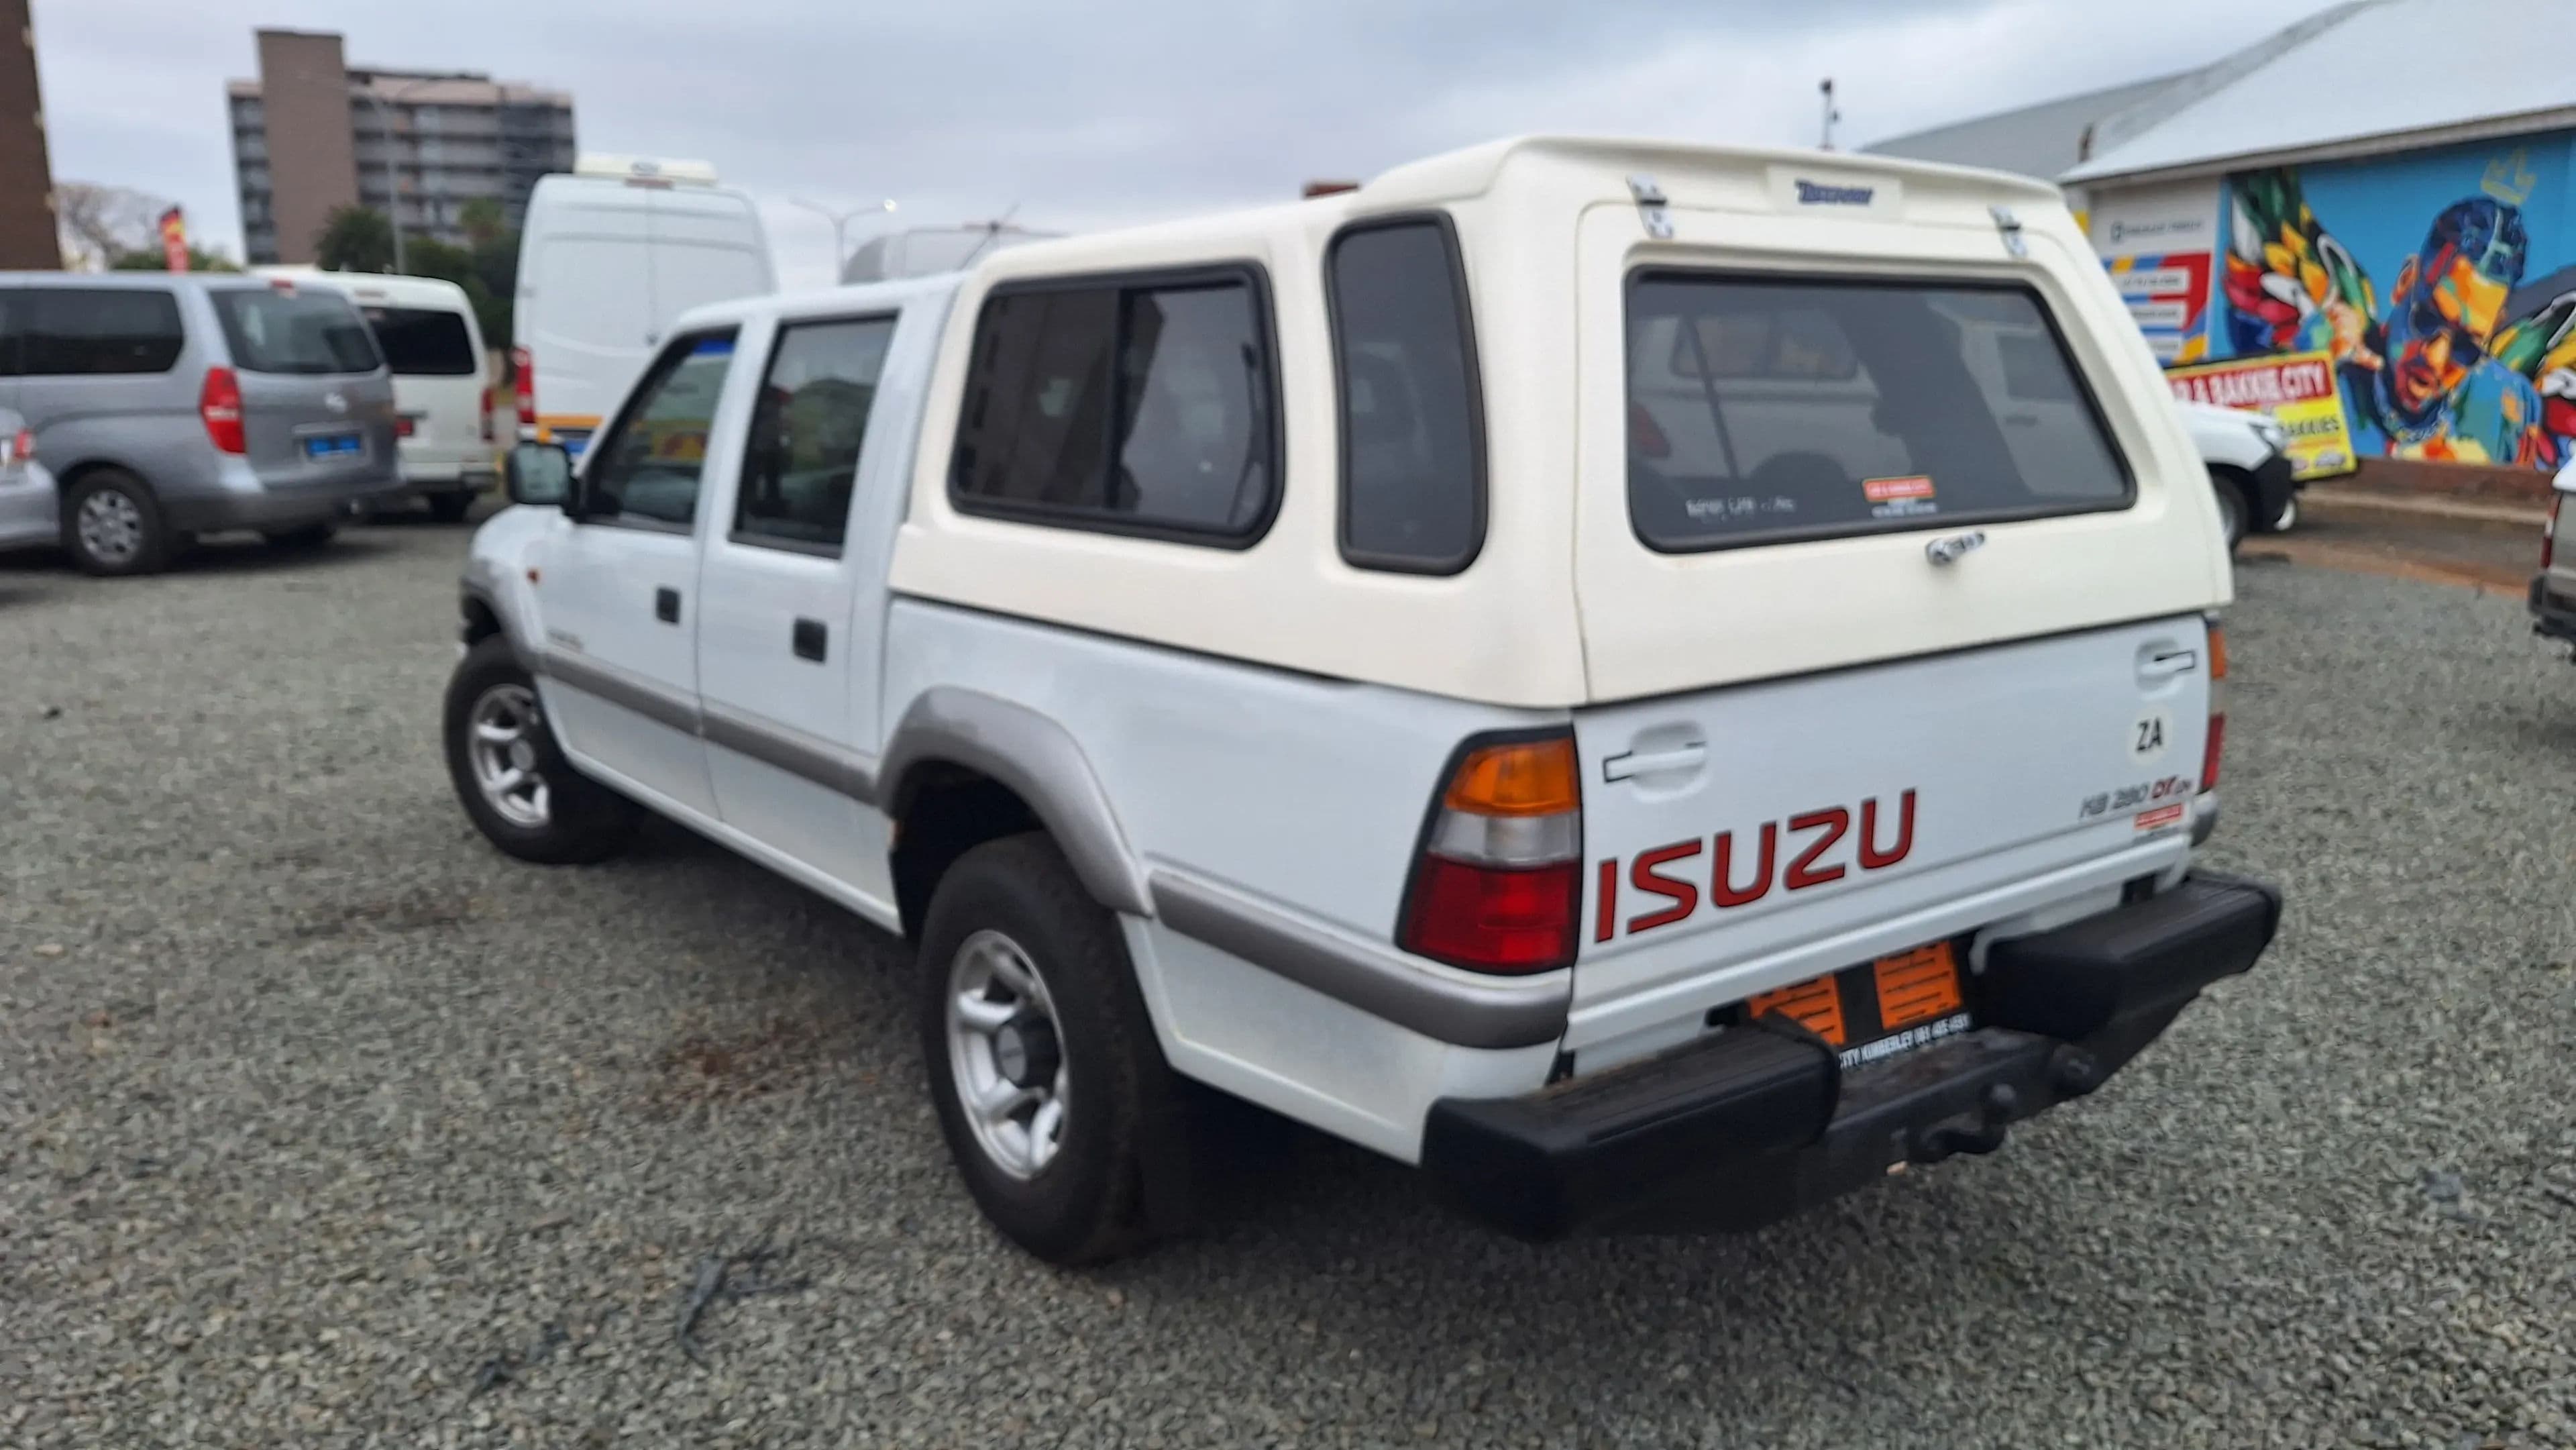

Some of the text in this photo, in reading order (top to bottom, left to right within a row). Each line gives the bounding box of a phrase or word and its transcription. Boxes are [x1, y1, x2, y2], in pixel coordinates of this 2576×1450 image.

[2281, 362, 2326, 401] CITY
[2136, 716, 2163, 752] ZA
[1594, 787, 1917, 944] ISUZU
